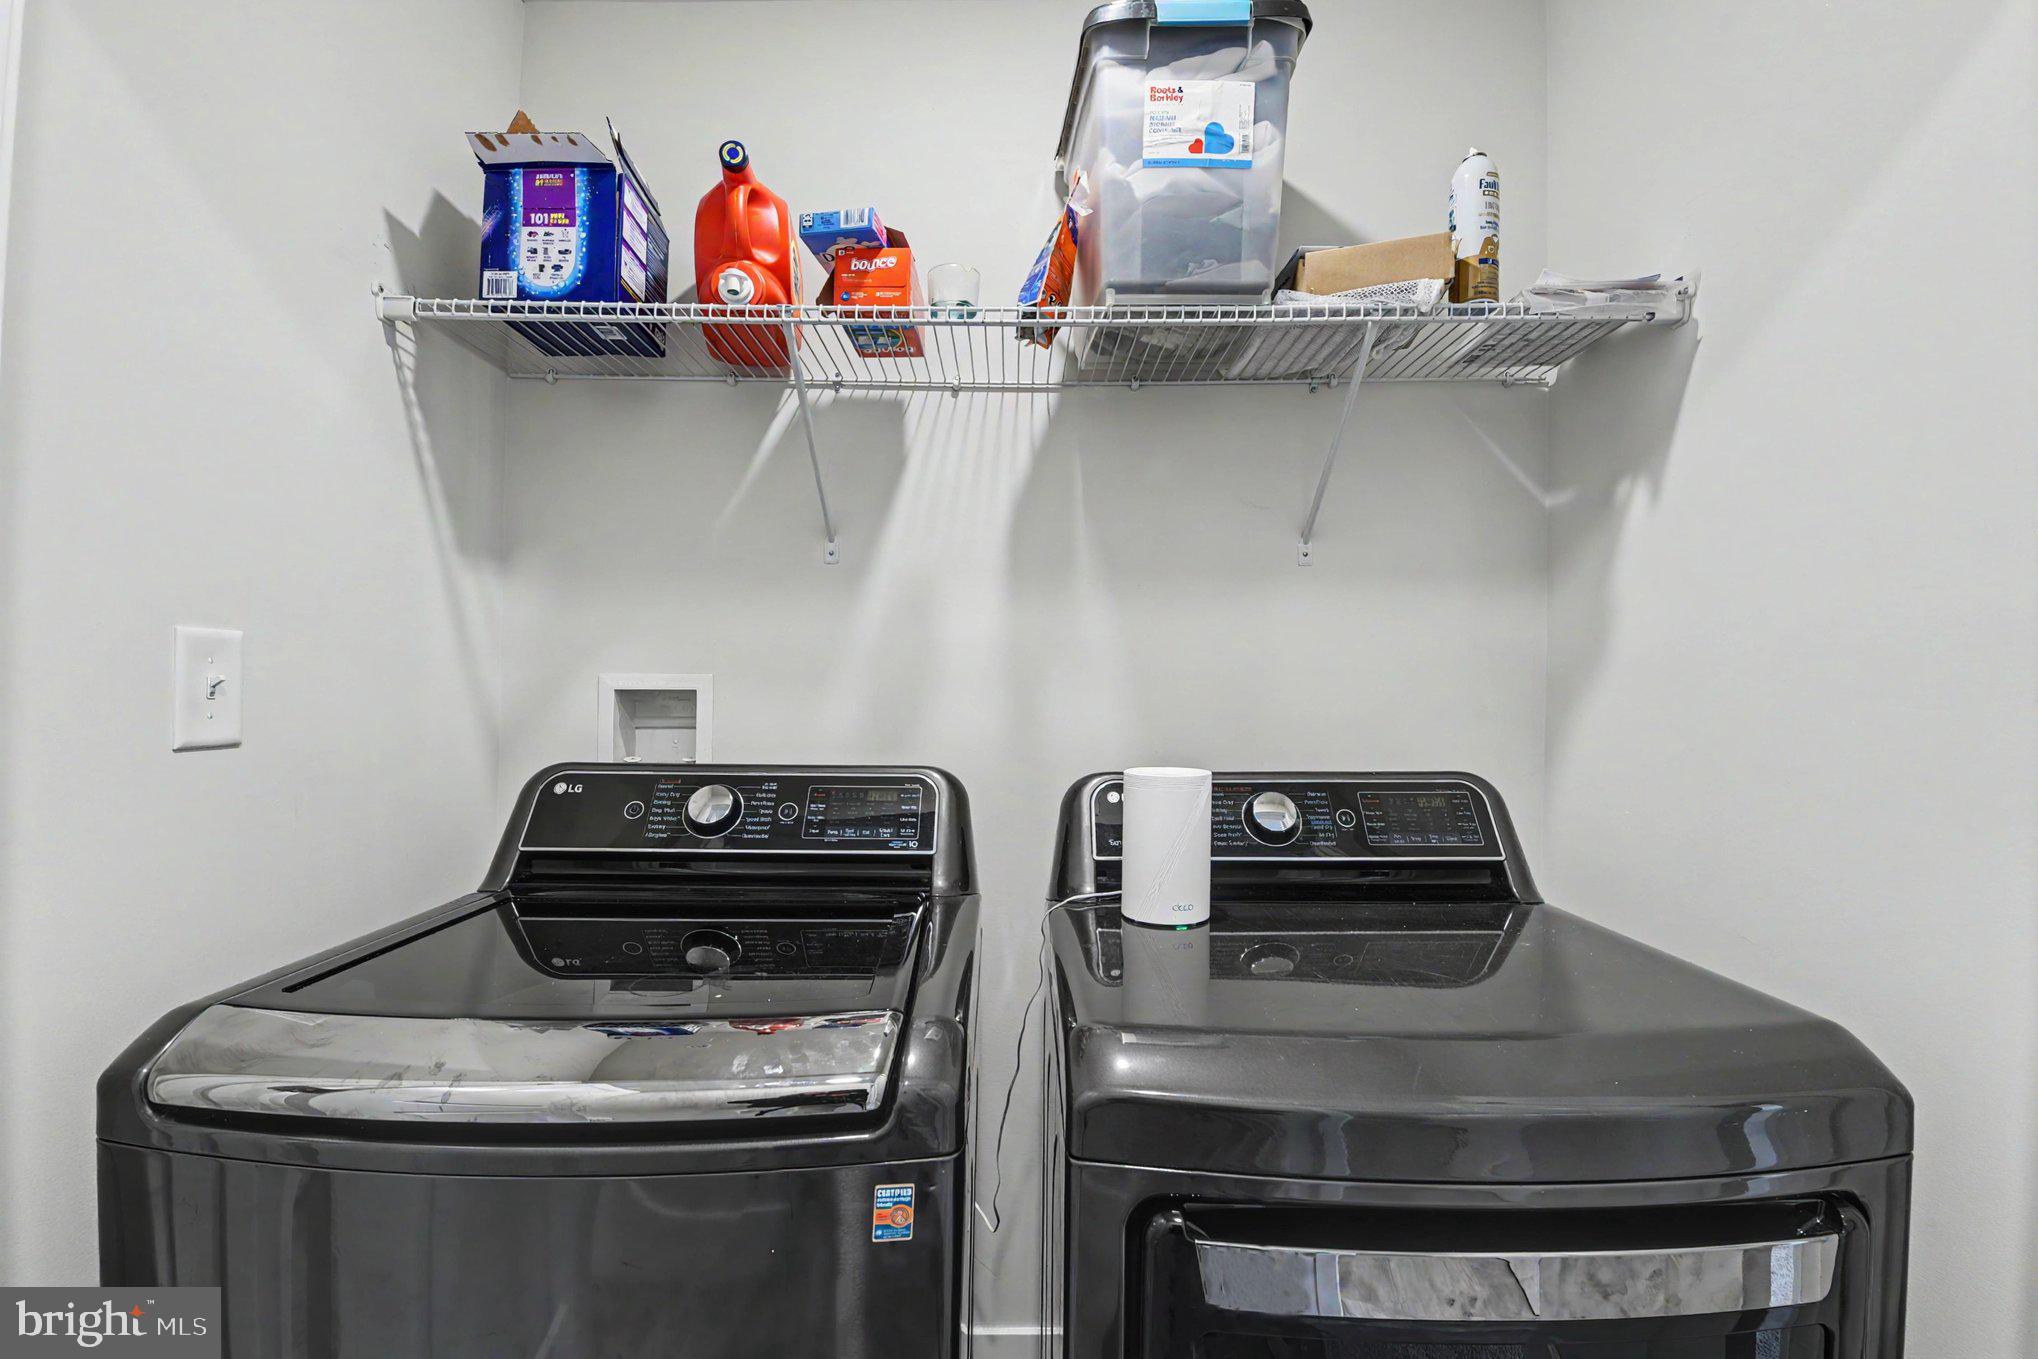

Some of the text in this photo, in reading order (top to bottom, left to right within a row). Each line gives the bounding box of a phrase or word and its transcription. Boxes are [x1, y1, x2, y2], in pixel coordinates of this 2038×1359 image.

[530, 212, 549, 225] 101
[850, 255, 898, 273] bounce
[567, 784, 583, 793] LG
